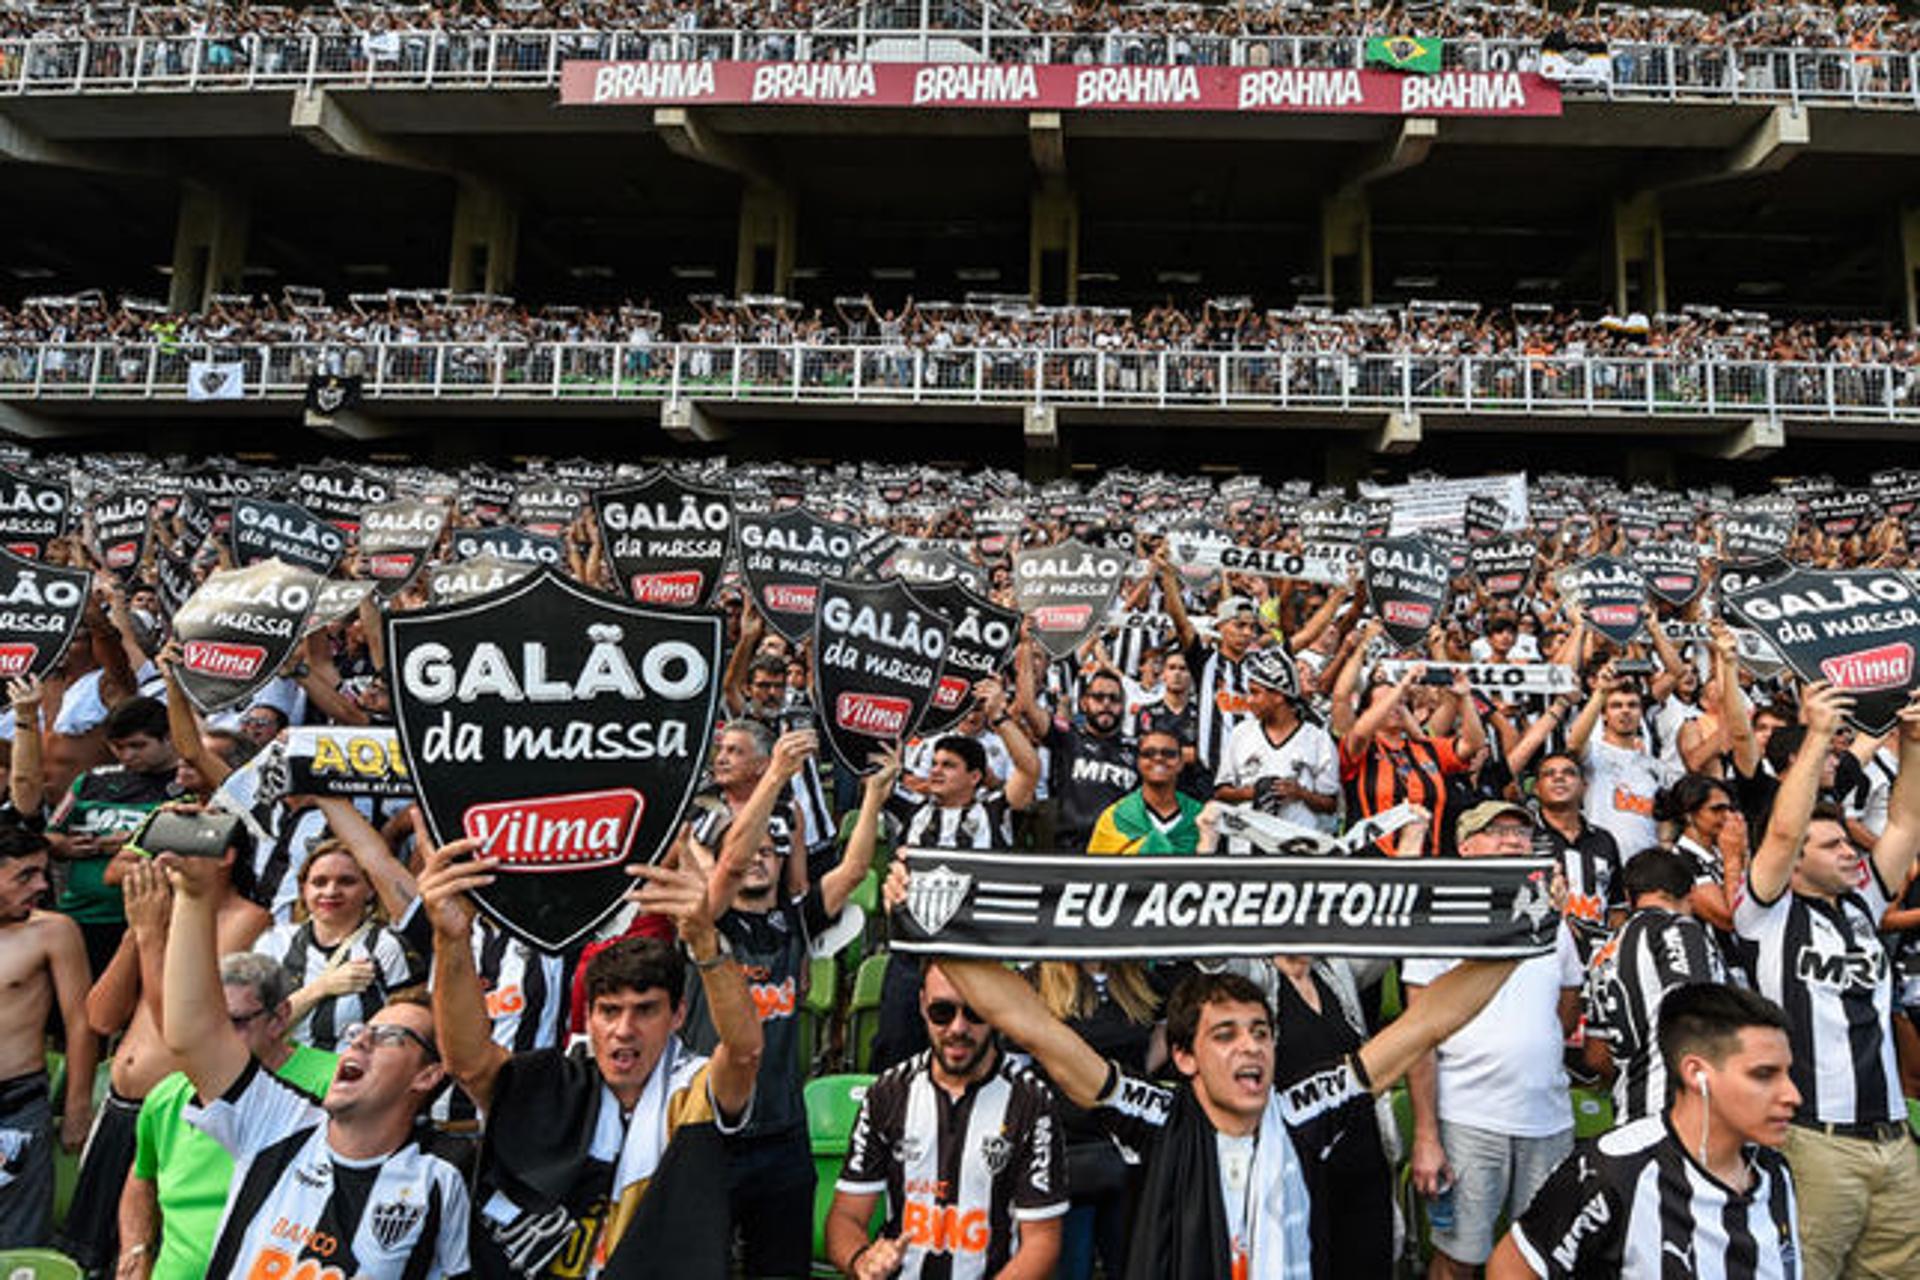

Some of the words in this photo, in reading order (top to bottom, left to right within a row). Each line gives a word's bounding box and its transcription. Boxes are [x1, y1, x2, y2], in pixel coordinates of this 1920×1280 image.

[594, 62, 715, 102] BRAHMA
[752, 64, 876, 102] BRAHMA
[913, 65, 1039, 104] BRAHMA
[1075, 66, 1200, 107] BRAHMA
[1238, 69, 1363, 109] BRAHMA
[1401, 71, 1525, 112] BRAHMA
[300, 473, 386, 503] GALÃO
[519, 490, 579, 507] GALÃO
[1810, 494, 1870, 508] GALÃO
[238, 506, 341, 551] GALÃO
[367, 509, 439, 531] GALÃO
[604, 494, 729, 531] GALÃO
[239, 530, 266, 545] da
[270, 540, 331, 564] massa
[613, 533, 641, 557] da
[649, 539, 722, 557] massa
[741, 525, 850, 558] GALÃO
[1726, 521, 1788, 544] GALÃO
[458, 539, 558, 563] GALÃO
[747, 551, 773, 570] da
[779, 558, 843, 576] massa
[1021, 553, 1118, 578] GALÃO
[1220, 547, 1304, 575] GALO
[1370, 547, 1447, 582] GALÃO
[1472, 541, 1536, 560] GALÃO
[0, 571, 80, 607] ÃO
[434, 568, 524, 594] GALÃ
[635, 580, 696, 602] Vilma
[1562, 565, 1643, 587] GALÃO
[1744, 578, 1910, 621] GALÃO
[0, 611, 66, 632] assa
[213, 611, 294, 638] massa
[823, 597, 943, 659] GALÃO
[1777, 620, 1818, 644] da
[1822, 607, 1920, 637] massa
[188, 645, 257, 674] Vilma
[404, 624, 709, 702] GALÃO
[824, 639, 859, 671] da
[865, 653, 933, 688] massa
[1828, 655, 1906, 687] Vilma
[840, 699, 903, 729] Vilma
[423, 710, 484, 762] da
[504, 720, 688, 761] massa
[1072, 756, 1138, 790] MRV
[474, 810, 621, 854] Vilma
[1053, 881, 1128, 928] EU
[1132, 881, 1419, 928] ACREDITO!!!
[1291, 1067, 1348, 1111] MRV
[1030, 1115, 1051, 1192] MRV
[271, 1217, 338, 1258] BANCO
[903, 1199, 989, 1253] BMG
[1551, 1191, 1612, 1273] MRV
